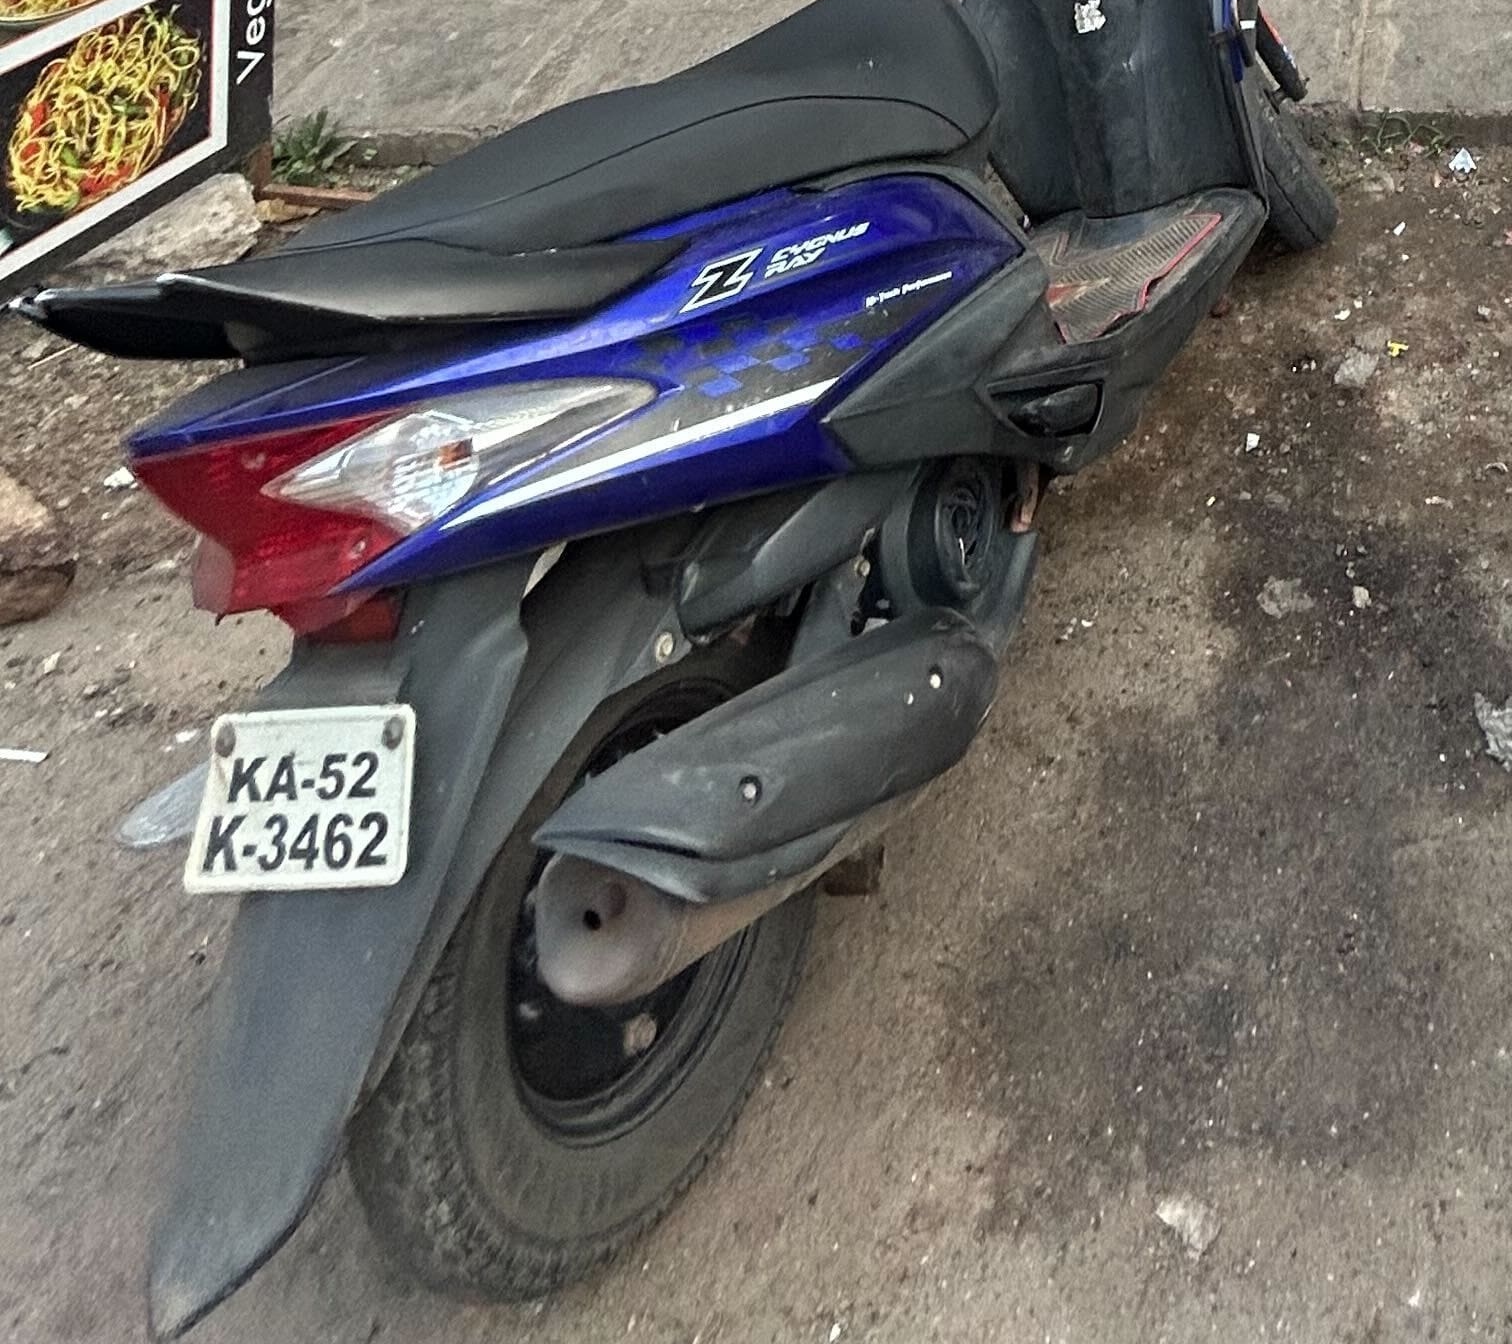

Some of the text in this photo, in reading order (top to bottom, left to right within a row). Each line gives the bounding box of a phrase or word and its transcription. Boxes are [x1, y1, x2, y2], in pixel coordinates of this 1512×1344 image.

[764, 246, 828, 279] RAY
[770, 221, 871, 264] CYGNUS
[227, 751, 380, 803] KA-52
[202, 811, 389, 872] K-3462
